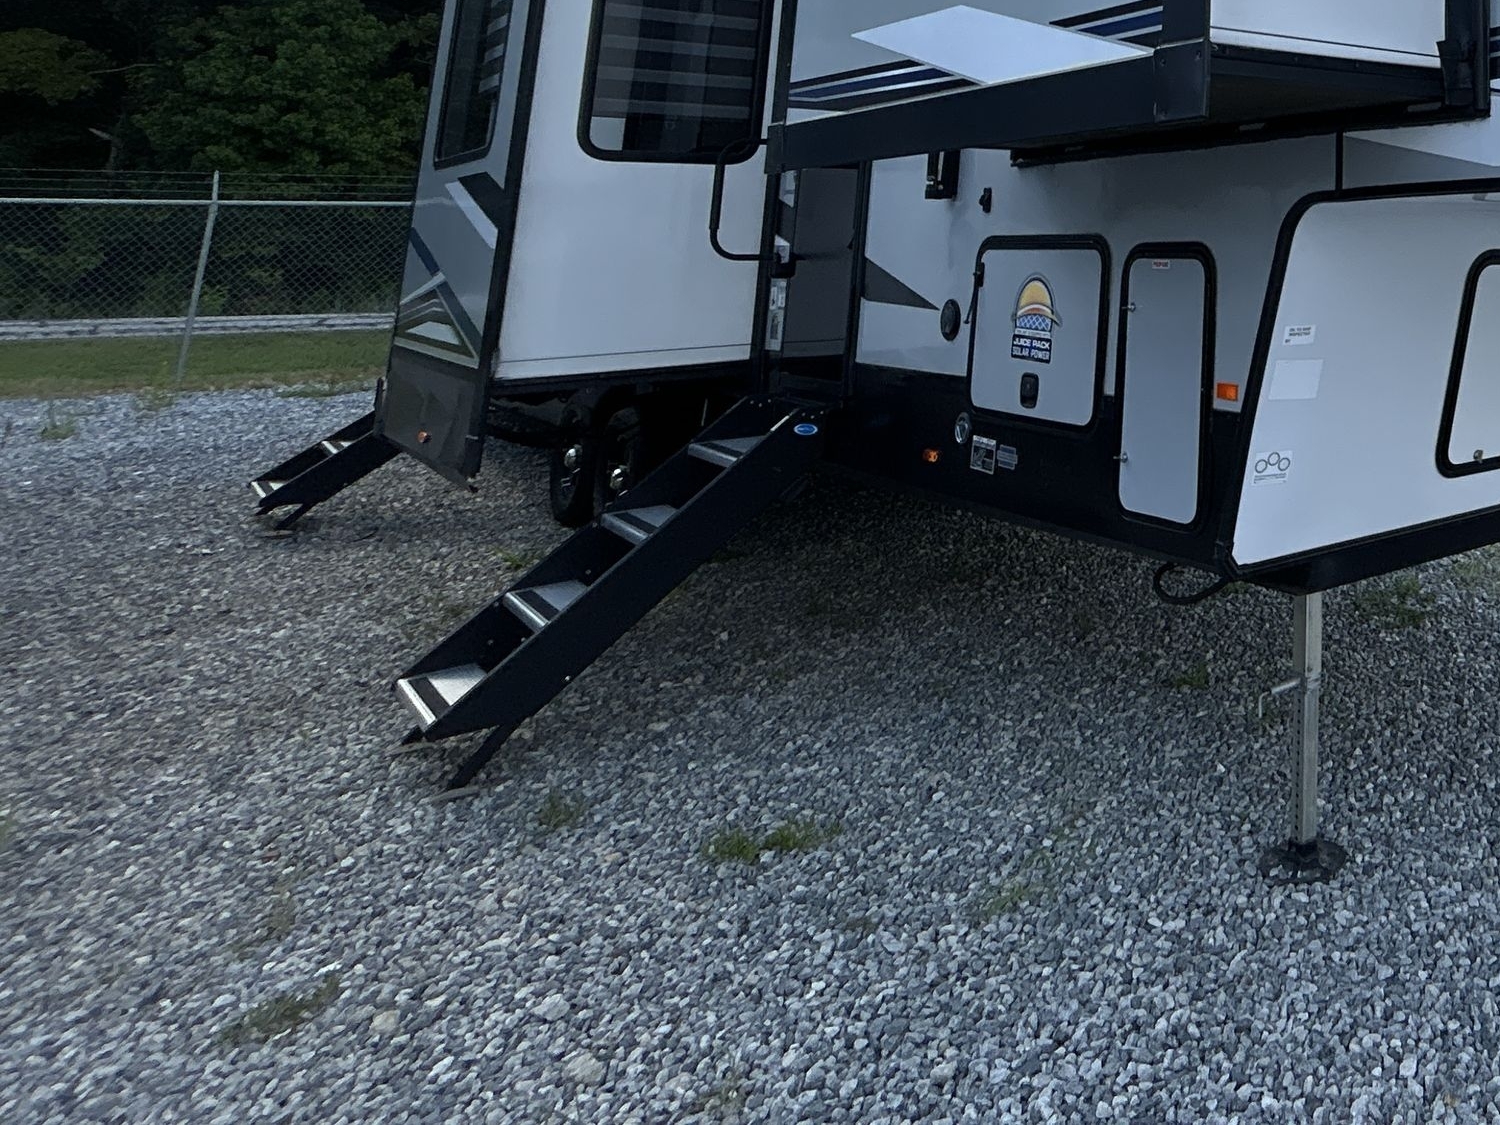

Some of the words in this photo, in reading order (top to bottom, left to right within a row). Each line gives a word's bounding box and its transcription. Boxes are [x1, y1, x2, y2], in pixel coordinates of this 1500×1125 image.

[1013, 337, 1031, 346] JUICE
[1032, 339, 1050, 350] PACK
[1012, 346, 1030, 356] SOLAR
[1030, 348, 1050, 360] POWER
